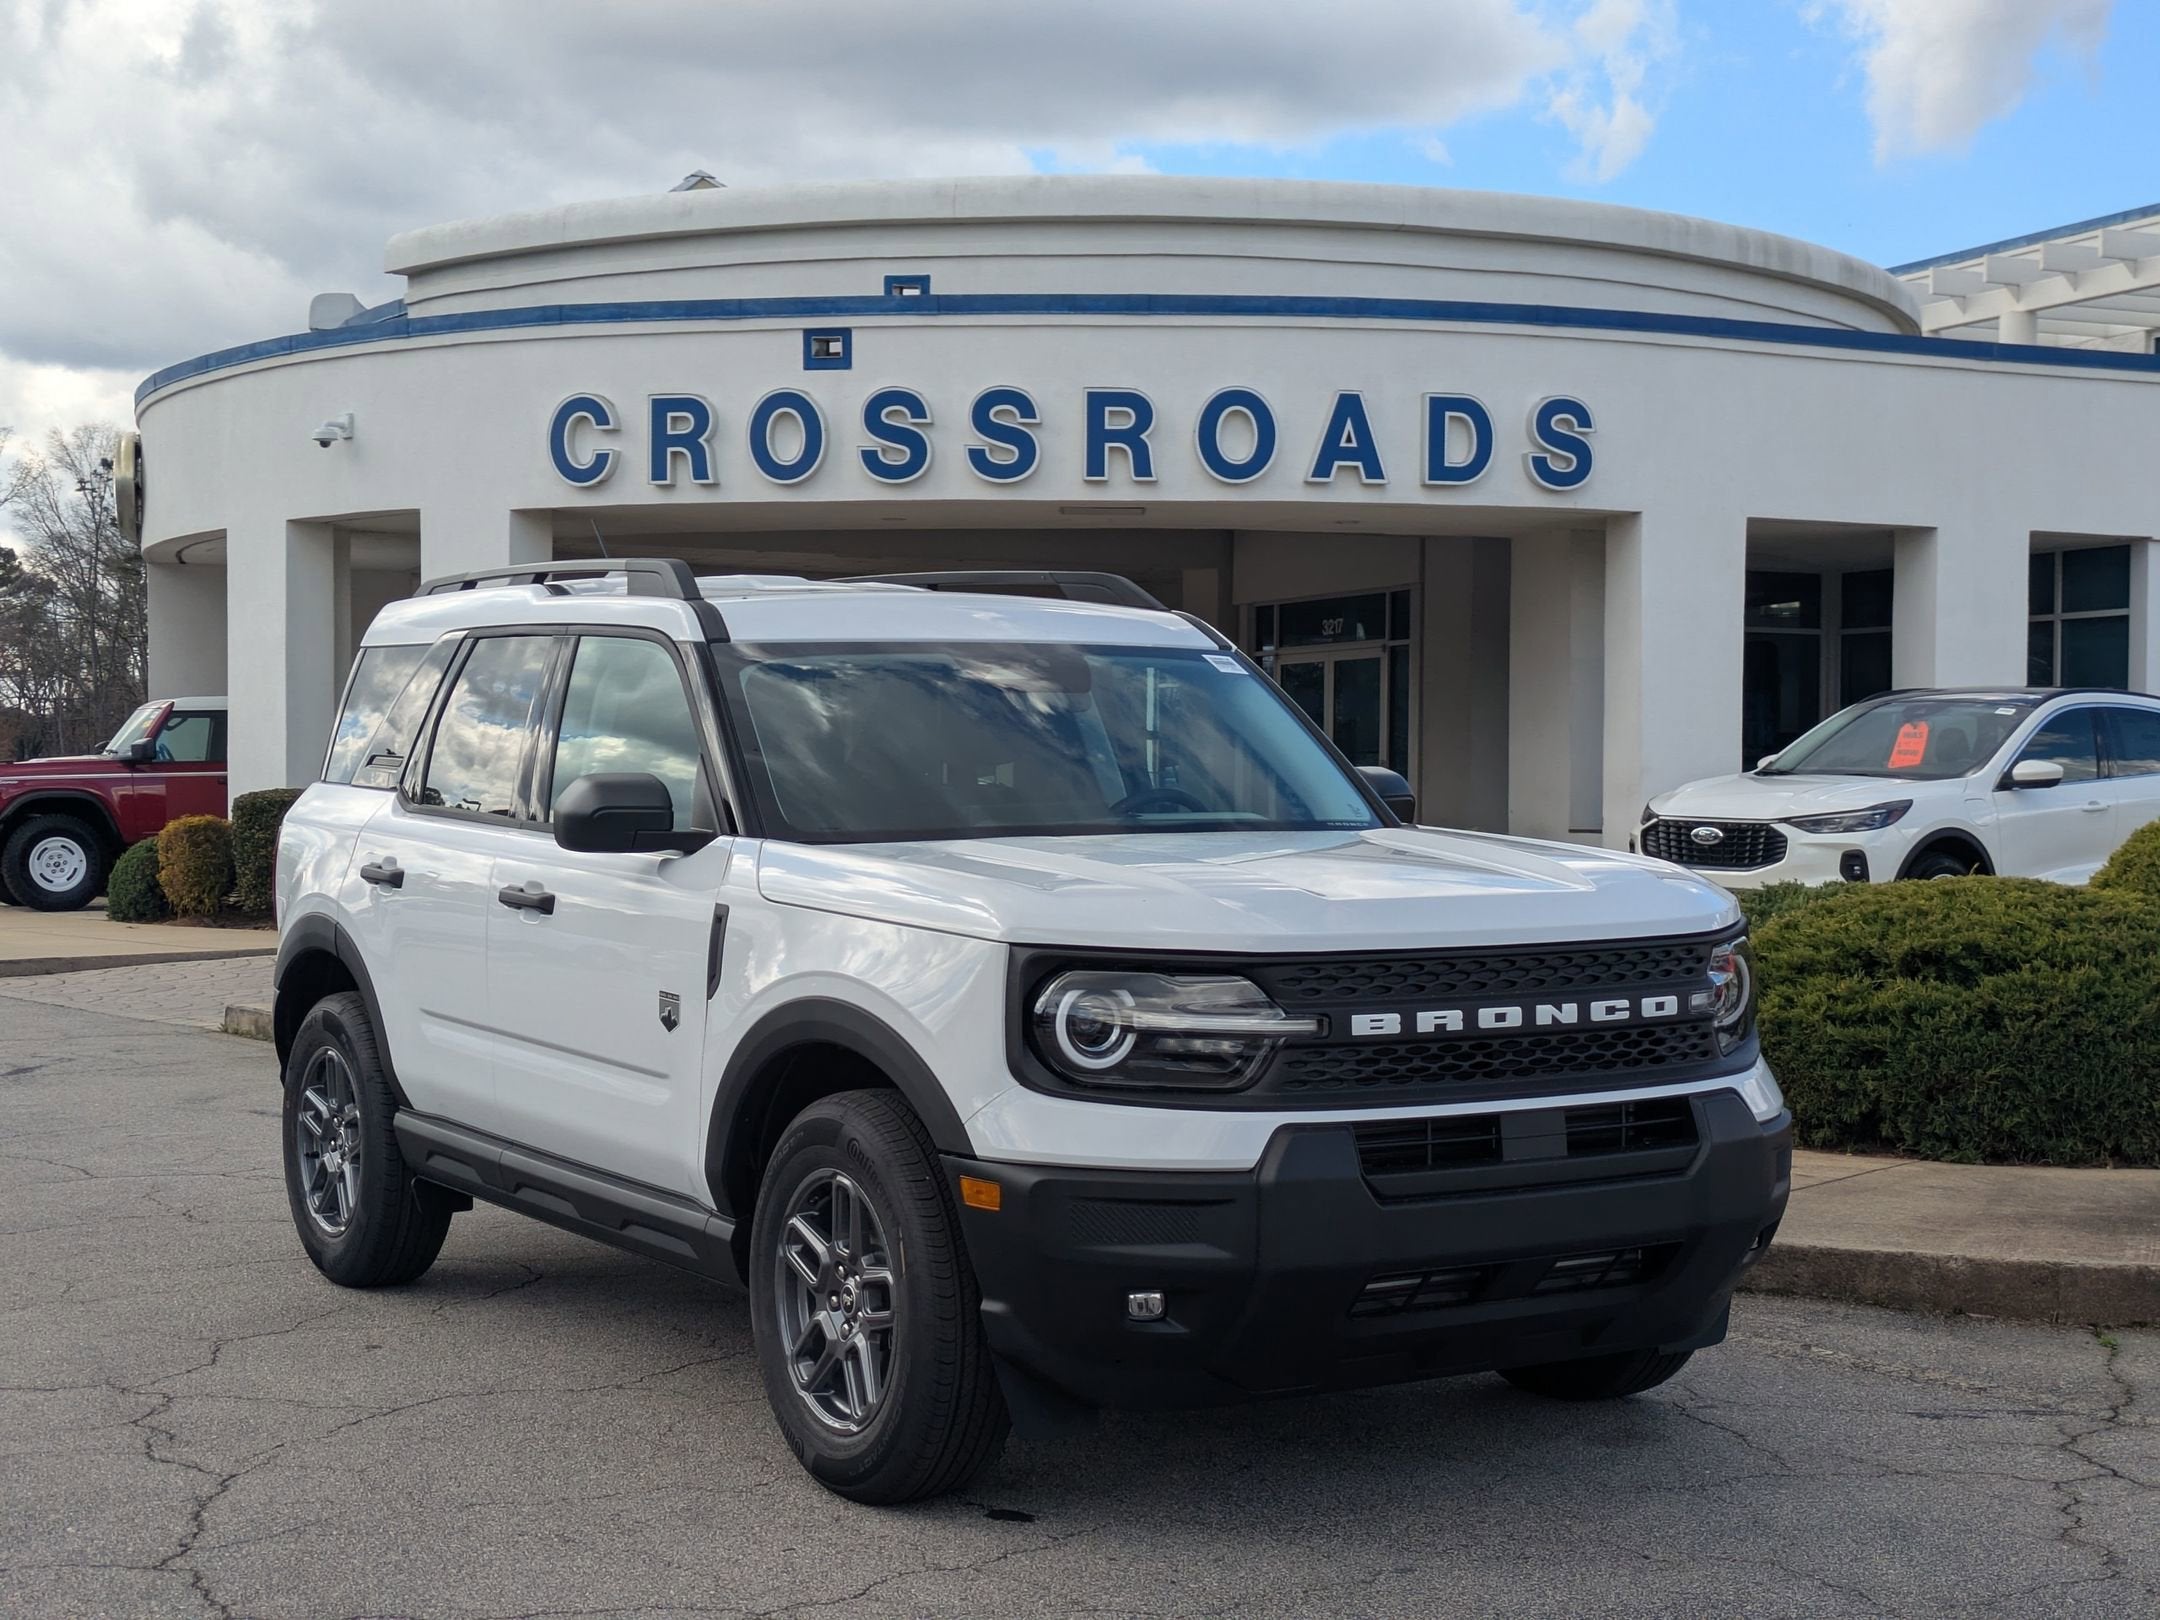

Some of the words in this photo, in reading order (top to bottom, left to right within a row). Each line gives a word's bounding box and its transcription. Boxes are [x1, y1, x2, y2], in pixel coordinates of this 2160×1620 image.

[549, 386, 1596, 490] CROSSROADS
[1321, 617, 1344, 636] 3217
[1351, 995, 1678, 1036] BRONCO
